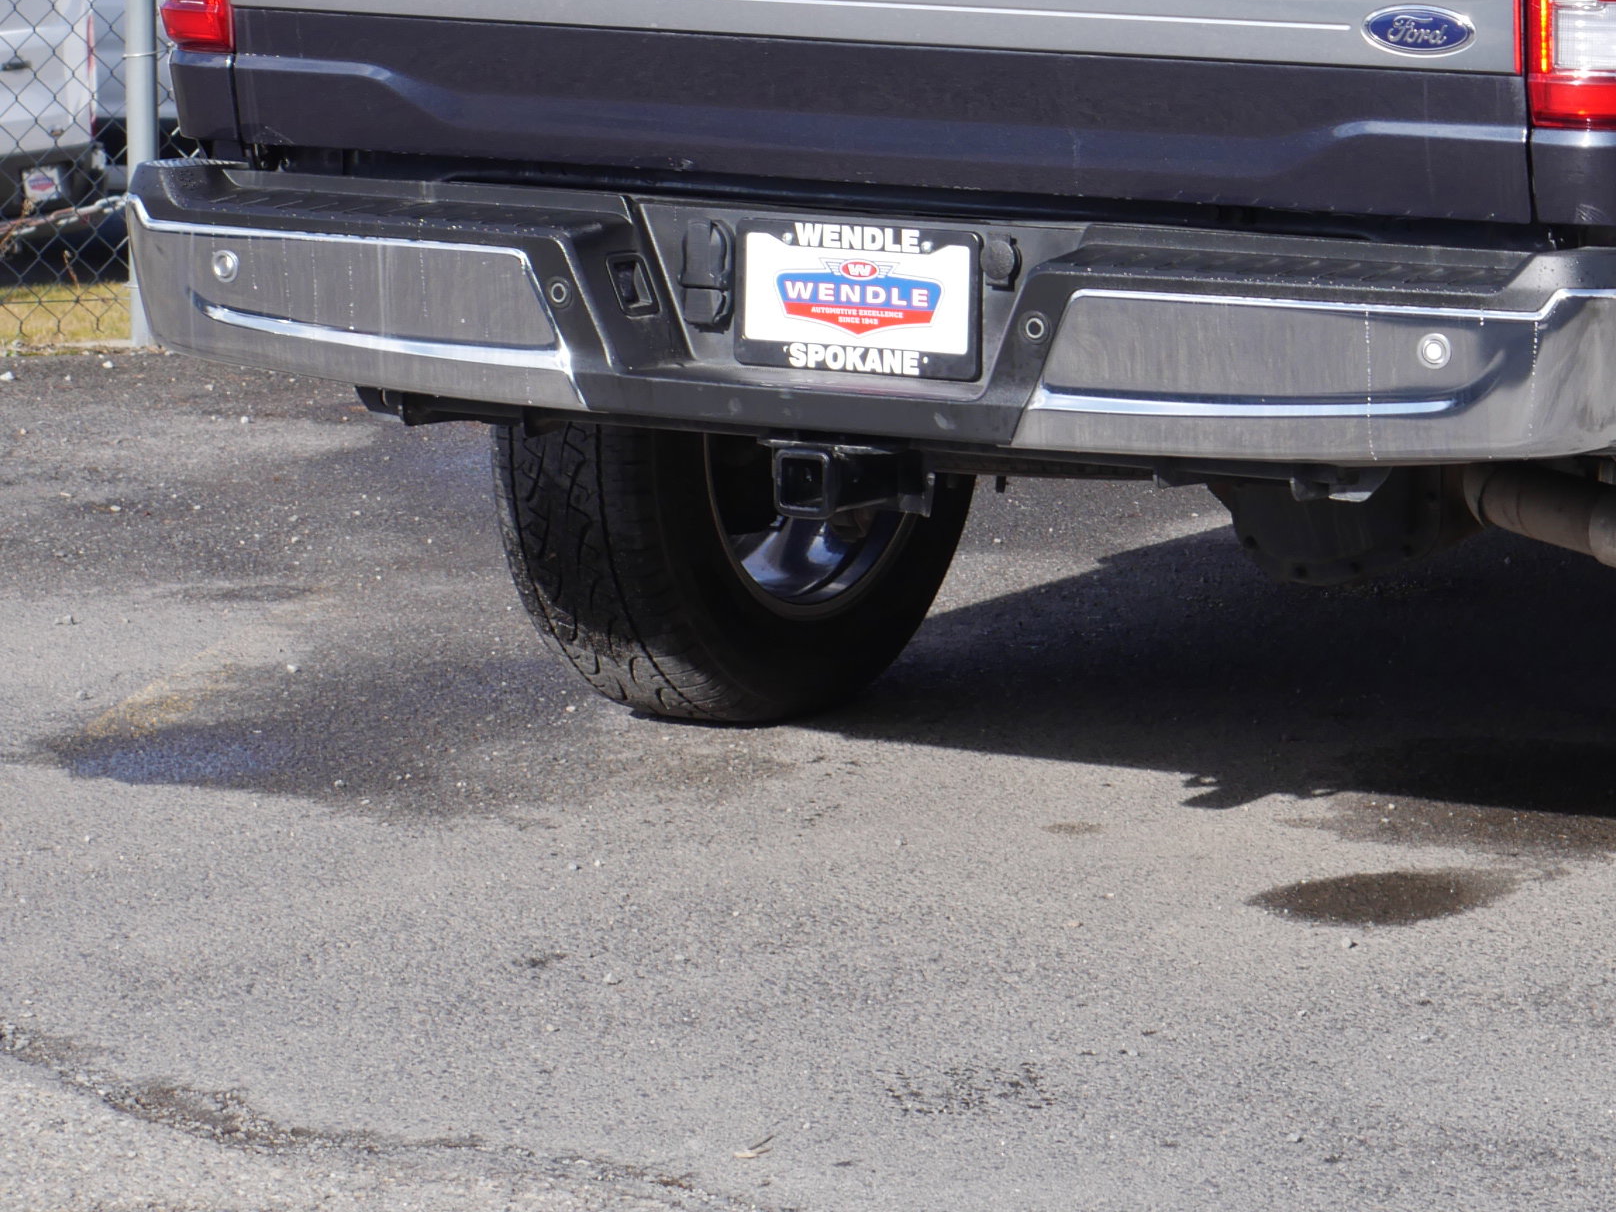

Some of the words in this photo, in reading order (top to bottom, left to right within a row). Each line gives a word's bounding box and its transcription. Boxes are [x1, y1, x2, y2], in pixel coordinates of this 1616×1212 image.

[1386, 15, 1448, 46] Ford
[795, 222, 920, 254] WENDLE
[784, 280, 929, 307] WENDLE
[811, 306, 857, 316] AUTOMOTIVE
[858, 309, 904, 319] EXCELLENCE
[838, 316, 860, 324] SINCE
[789, 343, 920, 376] SPOKANE
